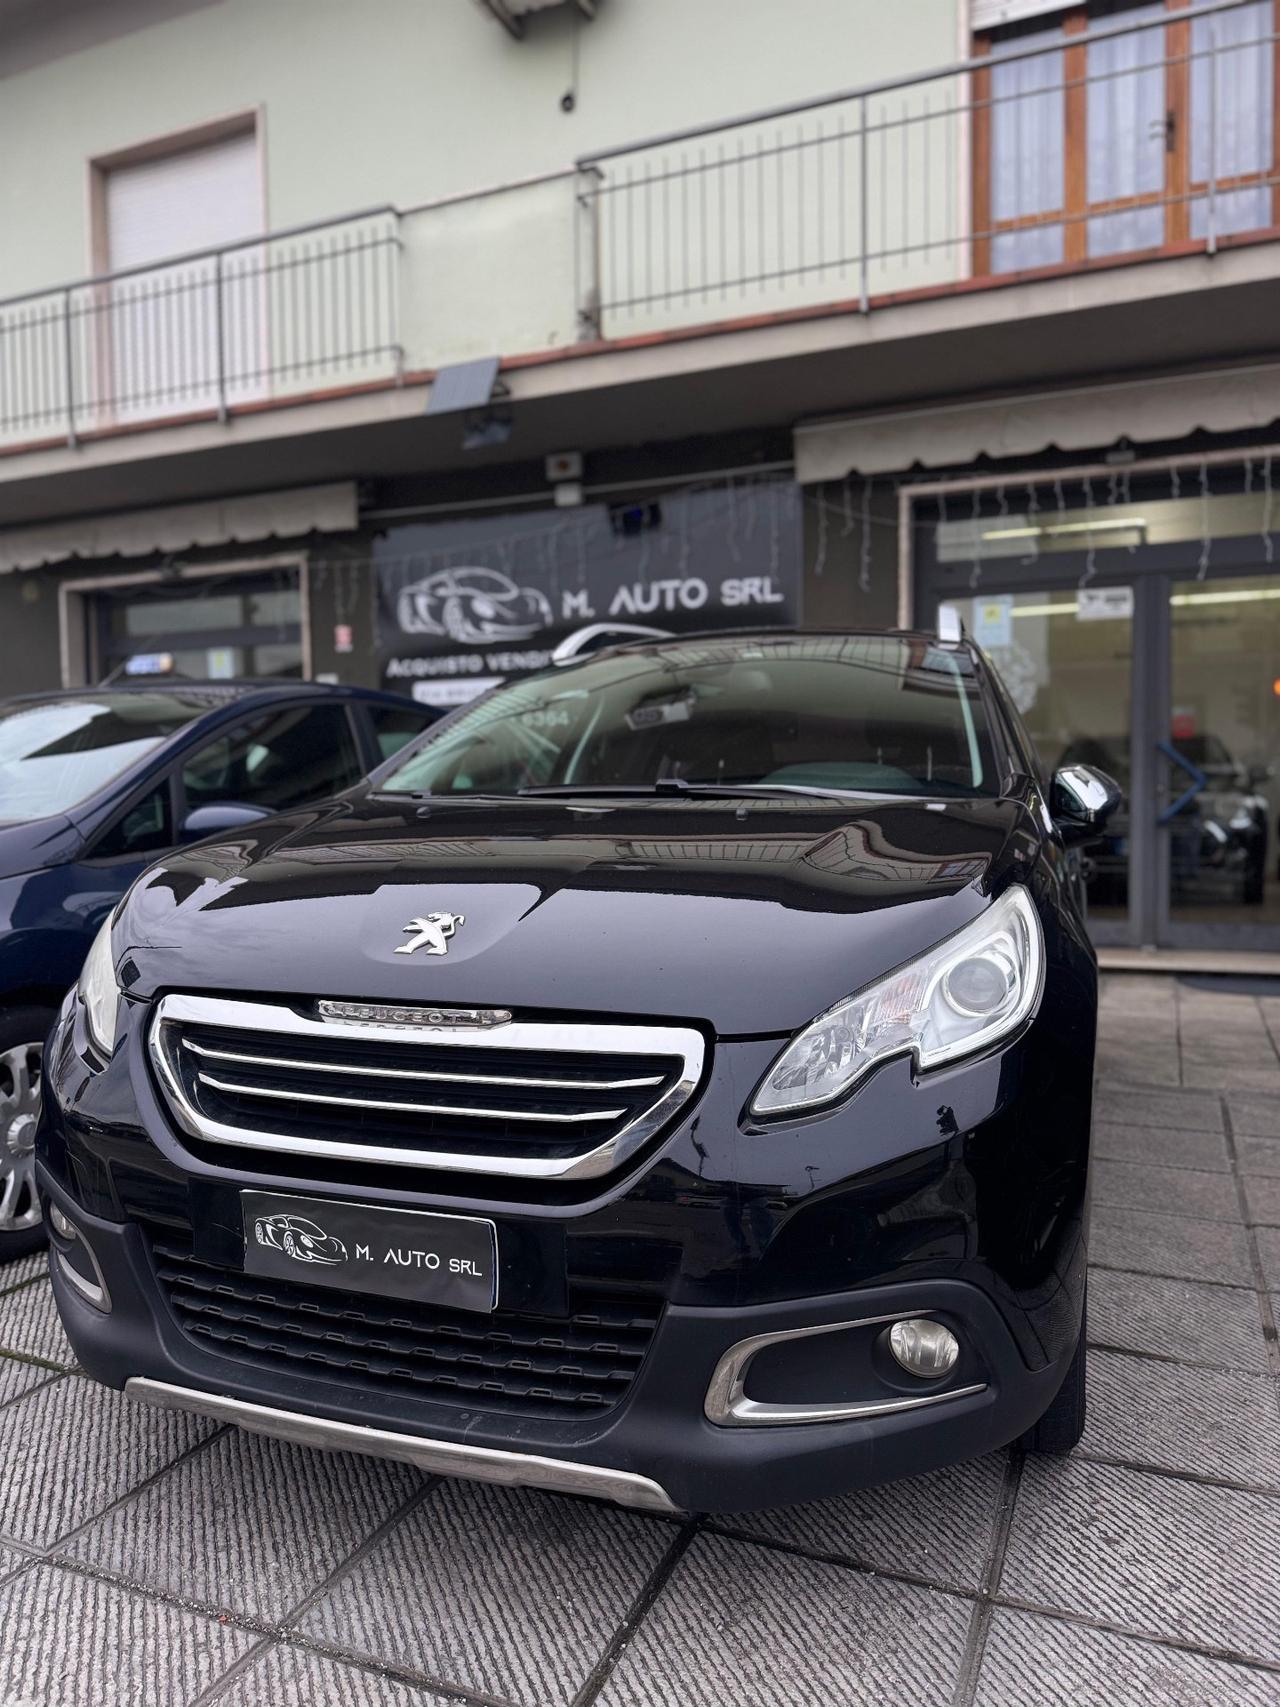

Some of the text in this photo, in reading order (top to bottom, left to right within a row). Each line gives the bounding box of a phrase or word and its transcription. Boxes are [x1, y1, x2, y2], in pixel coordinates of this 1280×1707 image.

[562, 577, 784, 619] M. AUTO SRL
[386, 653, 484, 678] ACQUISTO
[356, 1243, 483, 1277] M. AUTO SRL
